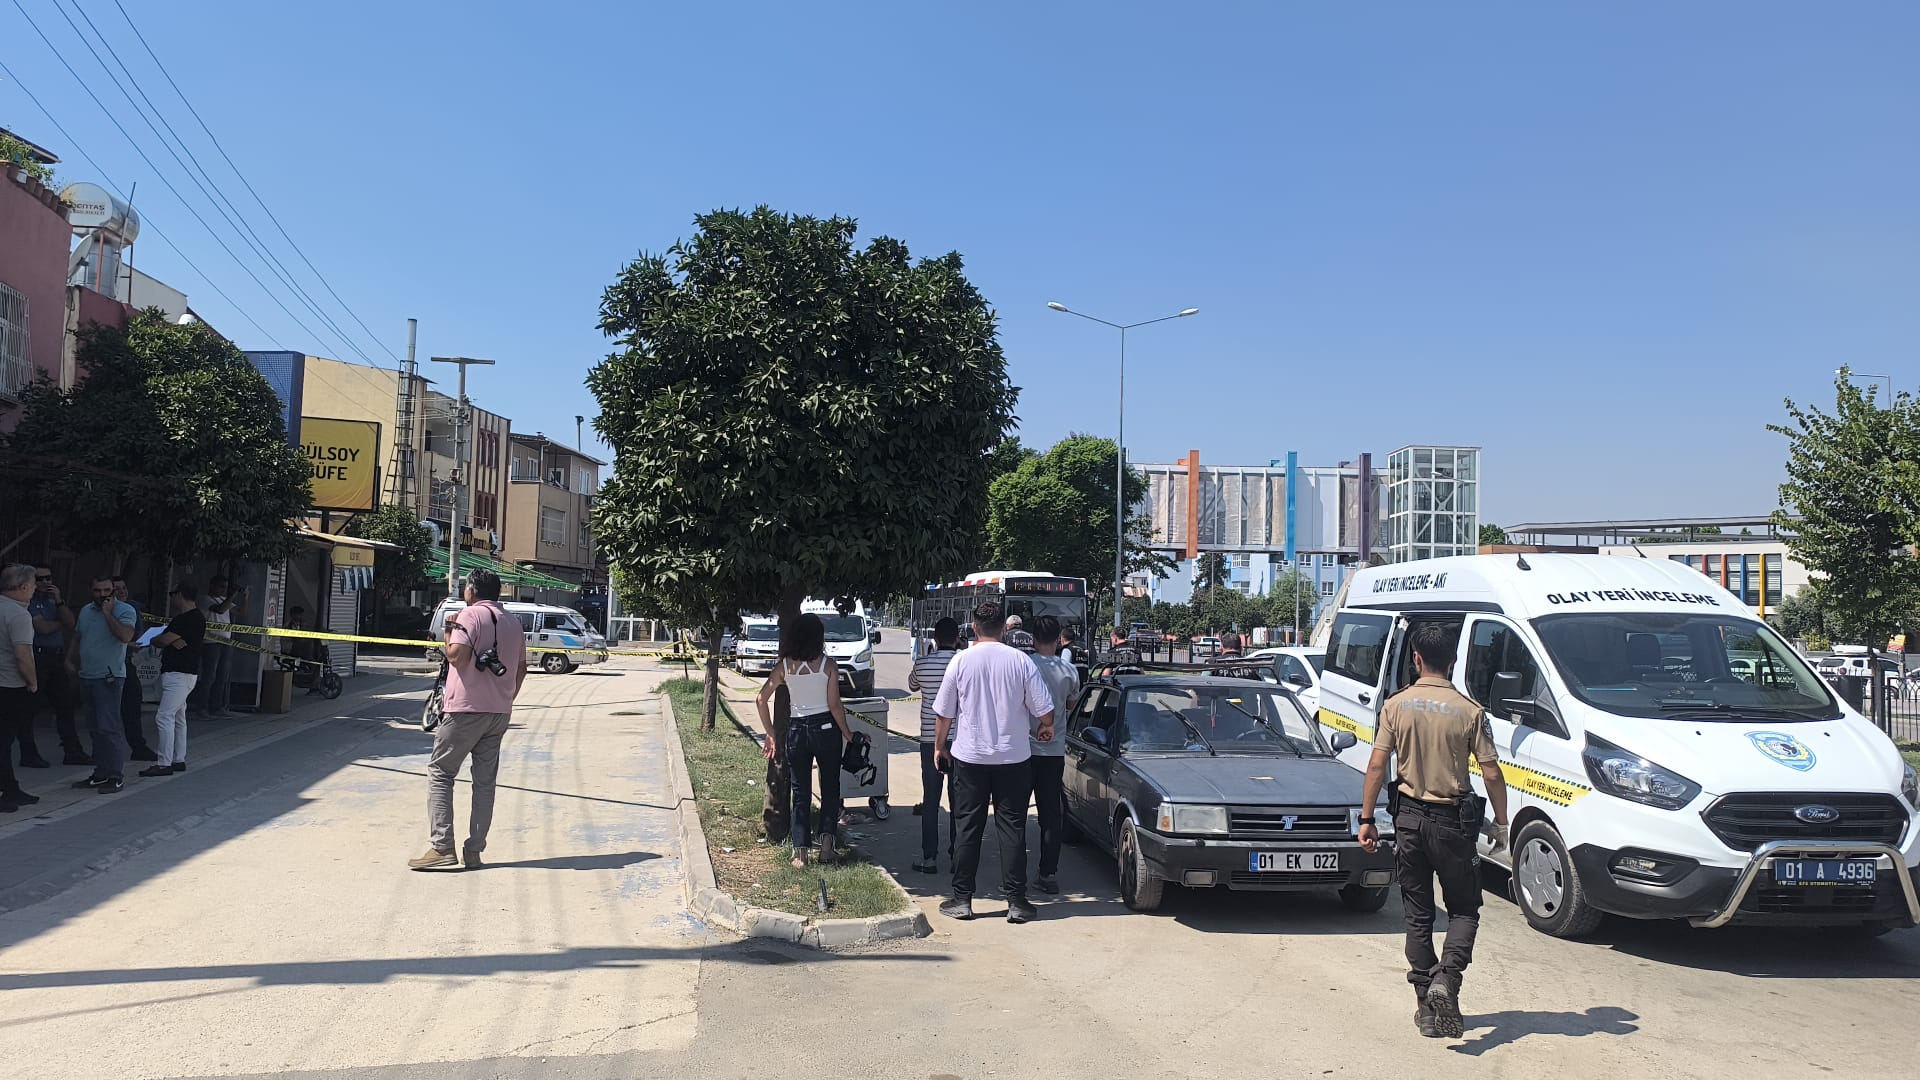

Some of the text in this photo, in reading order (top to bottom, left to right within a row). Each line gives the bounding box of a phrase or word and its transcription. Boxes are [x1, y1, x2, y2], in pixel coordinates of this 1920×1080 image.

[1547, 587, 1721, 607] OLAY YERİ İNCELEME
[1259, 854, 1274, 869] 01
[1286, 854, 1302, 870] EK
[1313, 854, 1337, 870] 022
[1786, 862, 1874, 880] 01 A 4936
